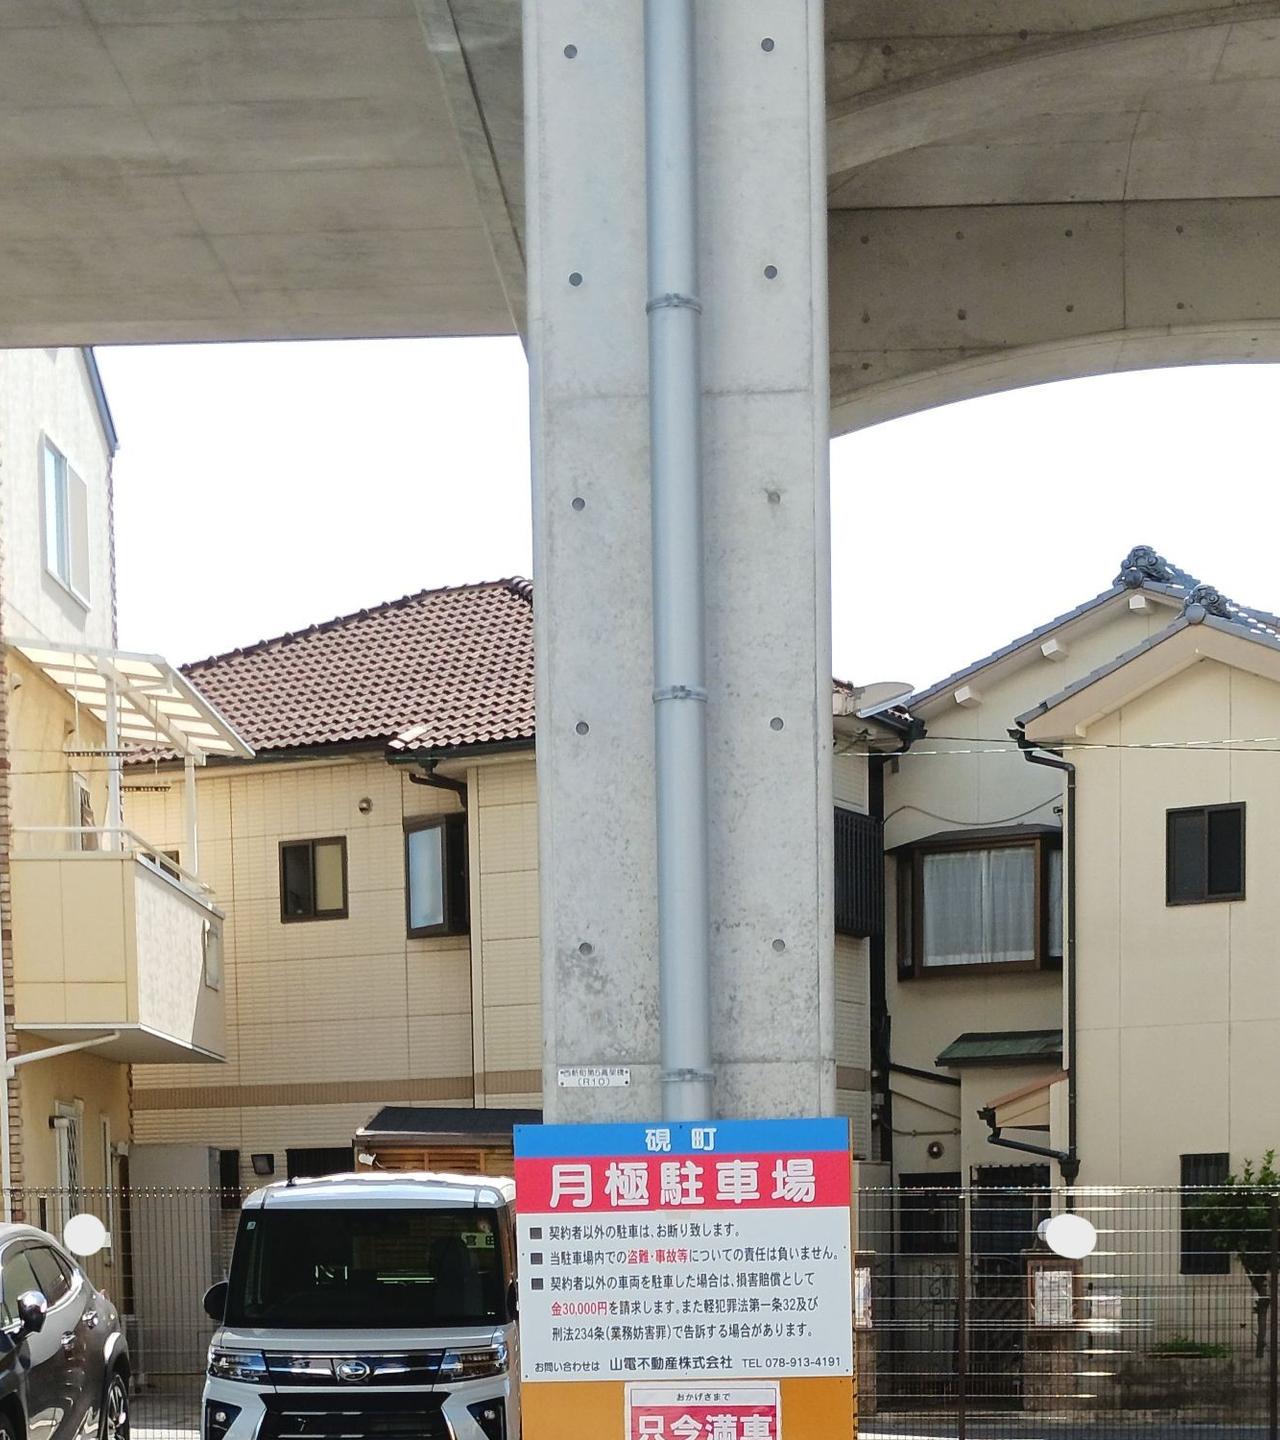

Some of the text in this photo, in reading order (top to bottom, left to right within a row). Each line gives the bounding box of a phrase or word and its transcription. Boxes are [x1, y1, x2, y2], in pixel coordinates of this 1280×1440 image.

[549, 1158, 816, 1208] 月極駐車場
[549, 1222, 740, 1241] 契約者以外の駐車は、お断り致します。
[550, 1271, 816, 1291] 契約者以外の車両を駐車した場合は、損害賠償として
[534, 1355, 841, 1373] お問い合わせは 山電不動産株式会社 TEL 078-913-4191
[676, 1392, 731, 1402] おかげさまで
